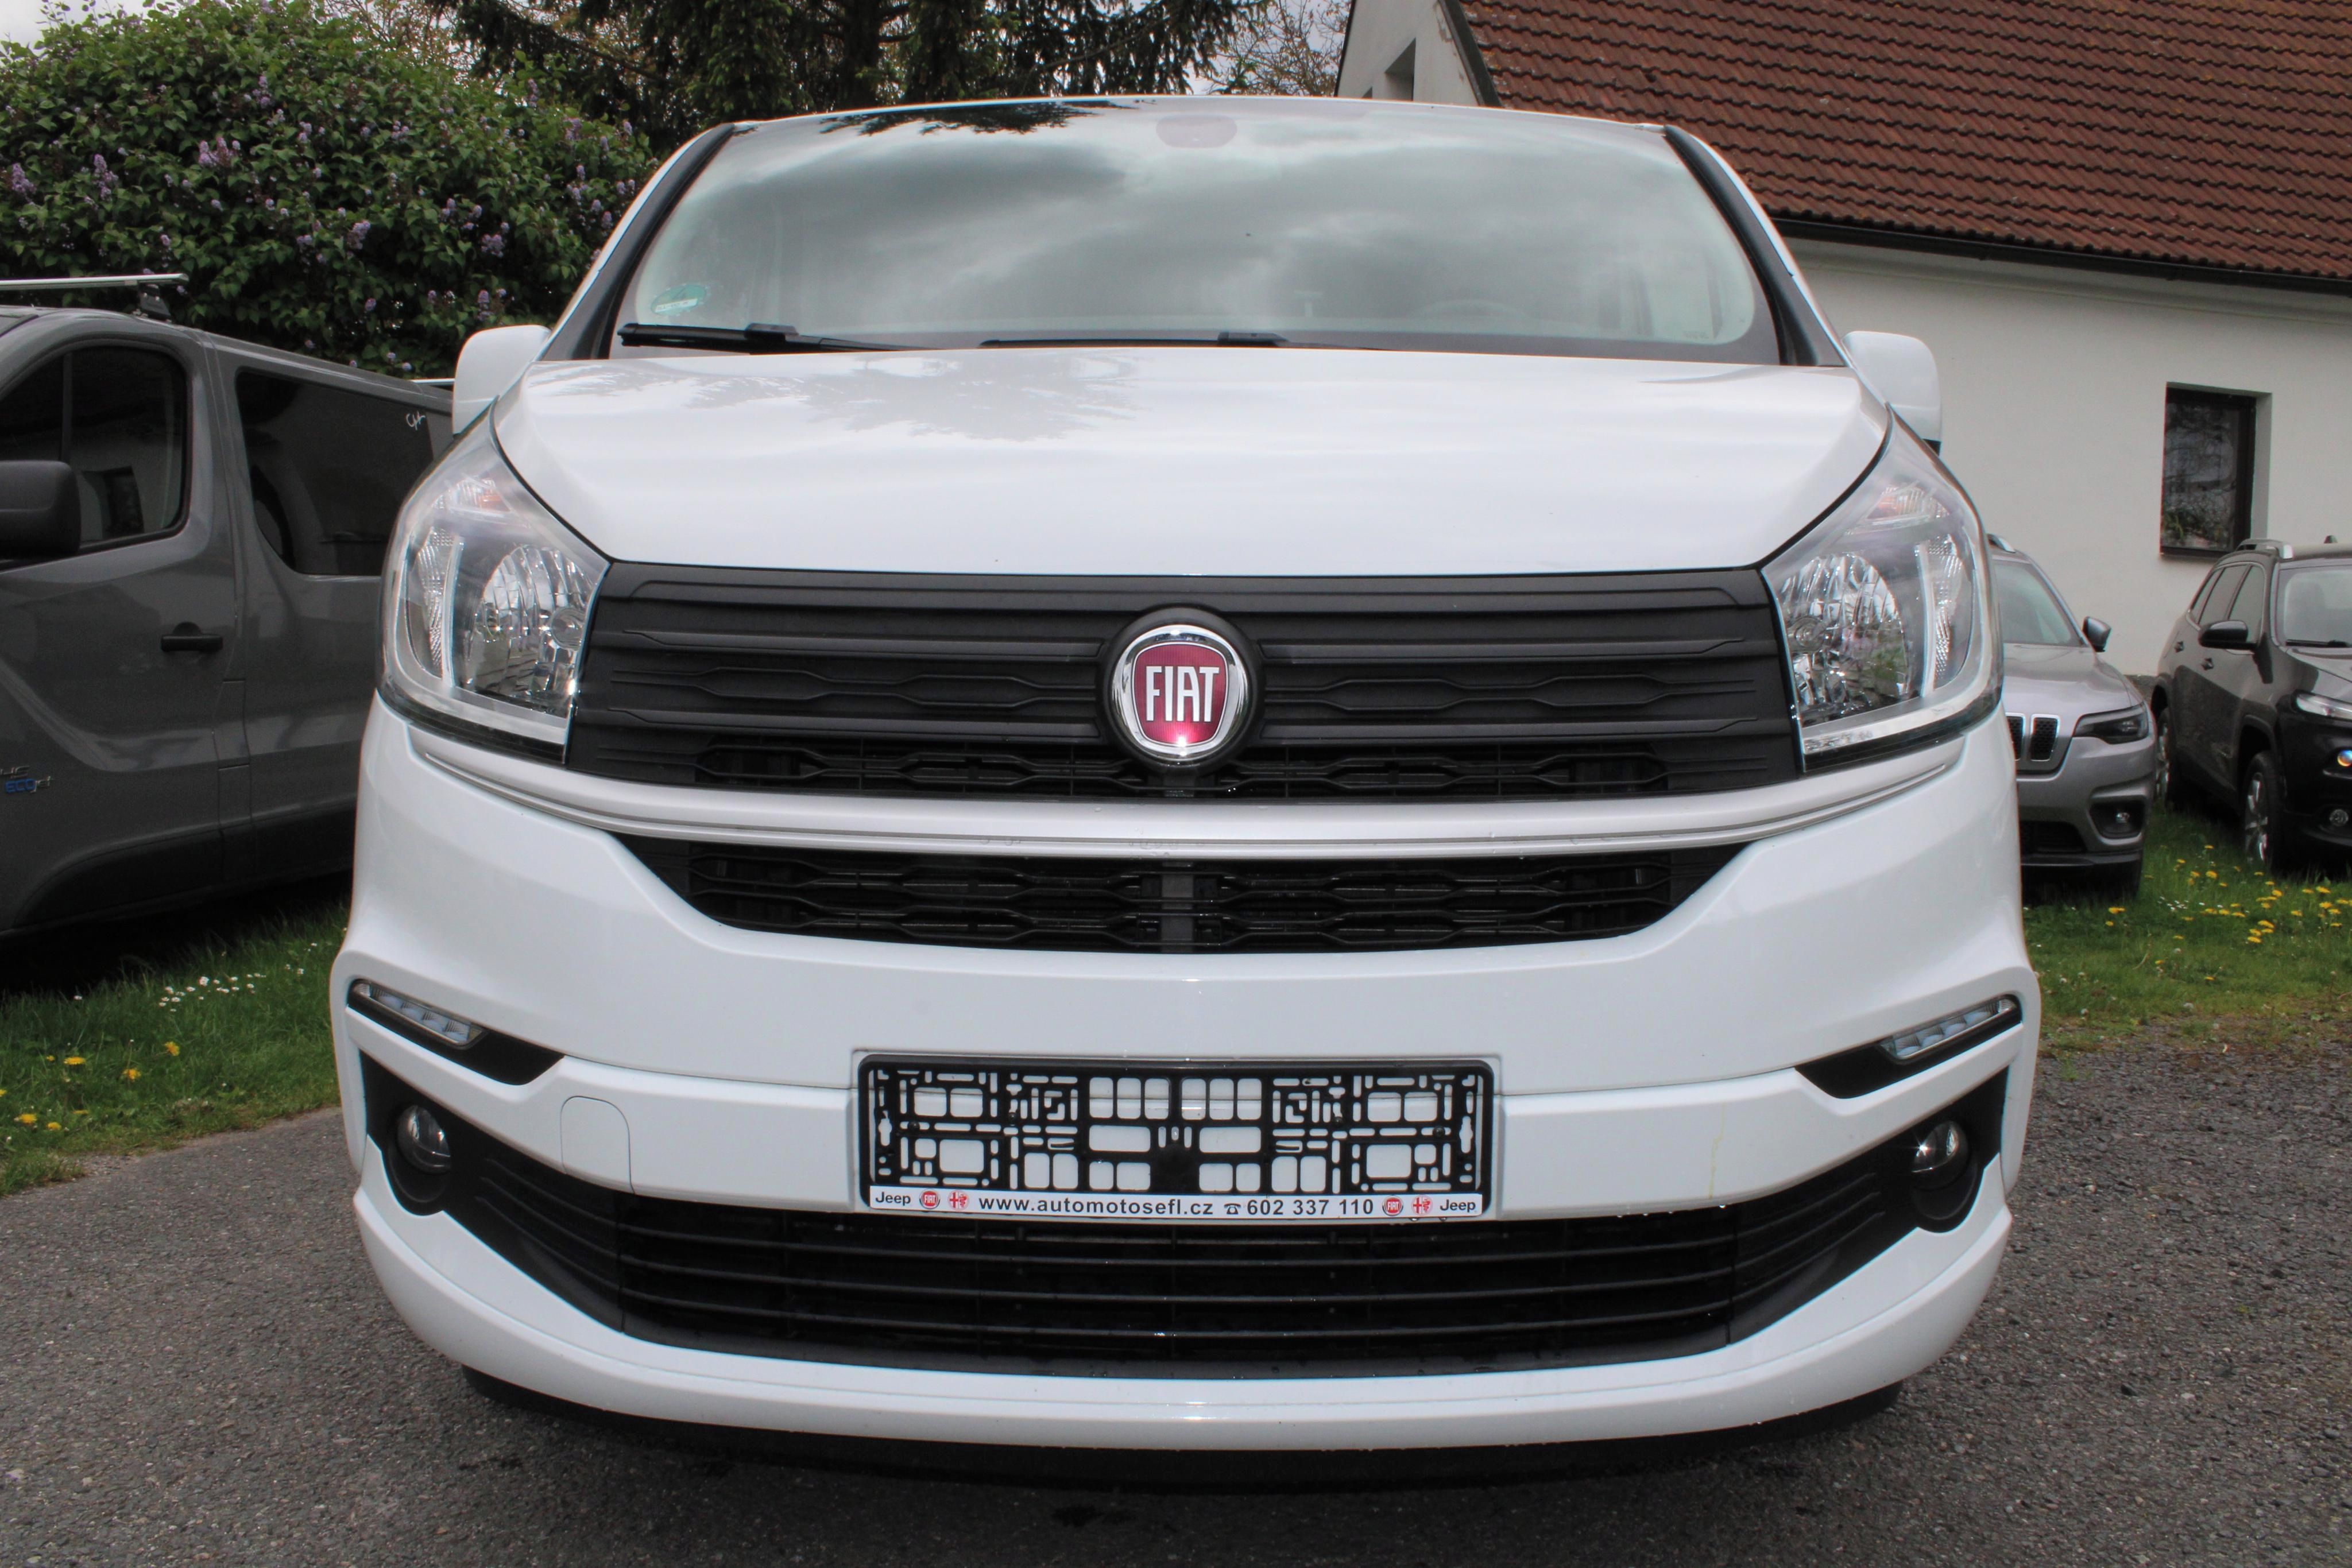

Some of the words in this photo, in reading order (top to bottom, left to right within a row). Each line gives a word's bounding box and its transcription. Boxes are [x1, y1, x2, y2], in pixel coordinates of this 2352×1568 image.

[1146, 665, 1219, 722] FIAT
[875, 1191, 911, 1206] Jeep
[924, 1194, 937, 1205] FIAT
[978, 1197, 1213, 1215] www.automotosefl.cz
[1247, 1199, 1284, 1215] 602
[1293, 1199, 1329, 1215] 337
[1339, 1198, 1374, 1215] 110
[1387, 1201, 1399, 1211] FIAT
[1440, 1199, 1476, 1213] Jeep
